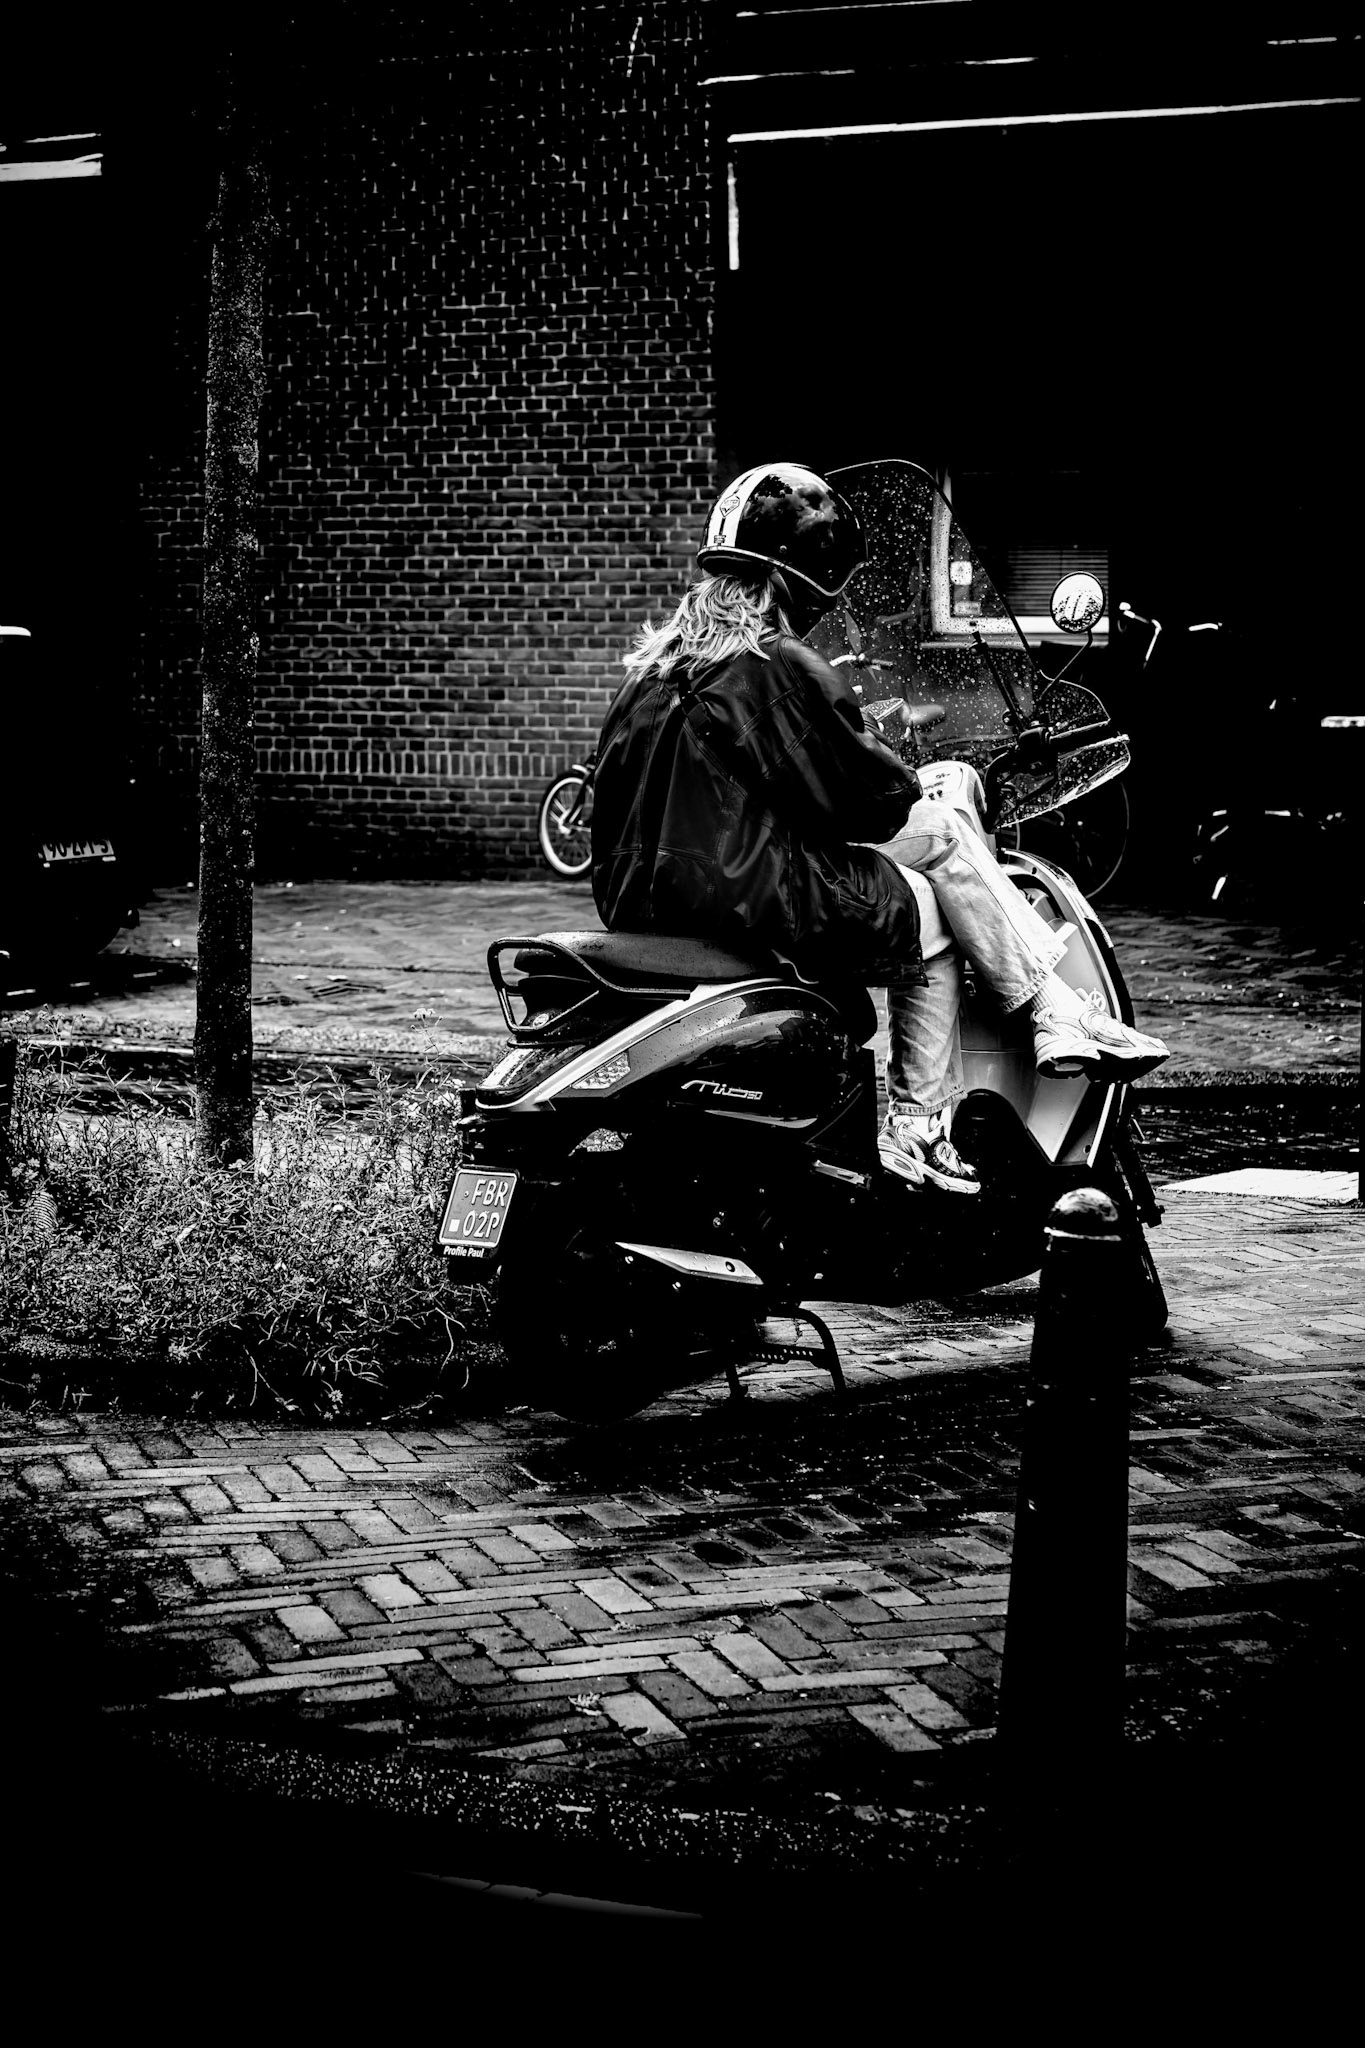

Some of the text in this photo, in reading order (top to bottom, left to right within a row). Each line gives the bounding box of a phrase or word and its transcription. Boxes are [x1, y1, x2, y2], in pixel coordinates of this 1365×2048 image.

[471, 1179, 509, 1207] FBR
[462, 1210, 500, 1238] 02P
[443, 1245, 485, 1258] Profile Paul
